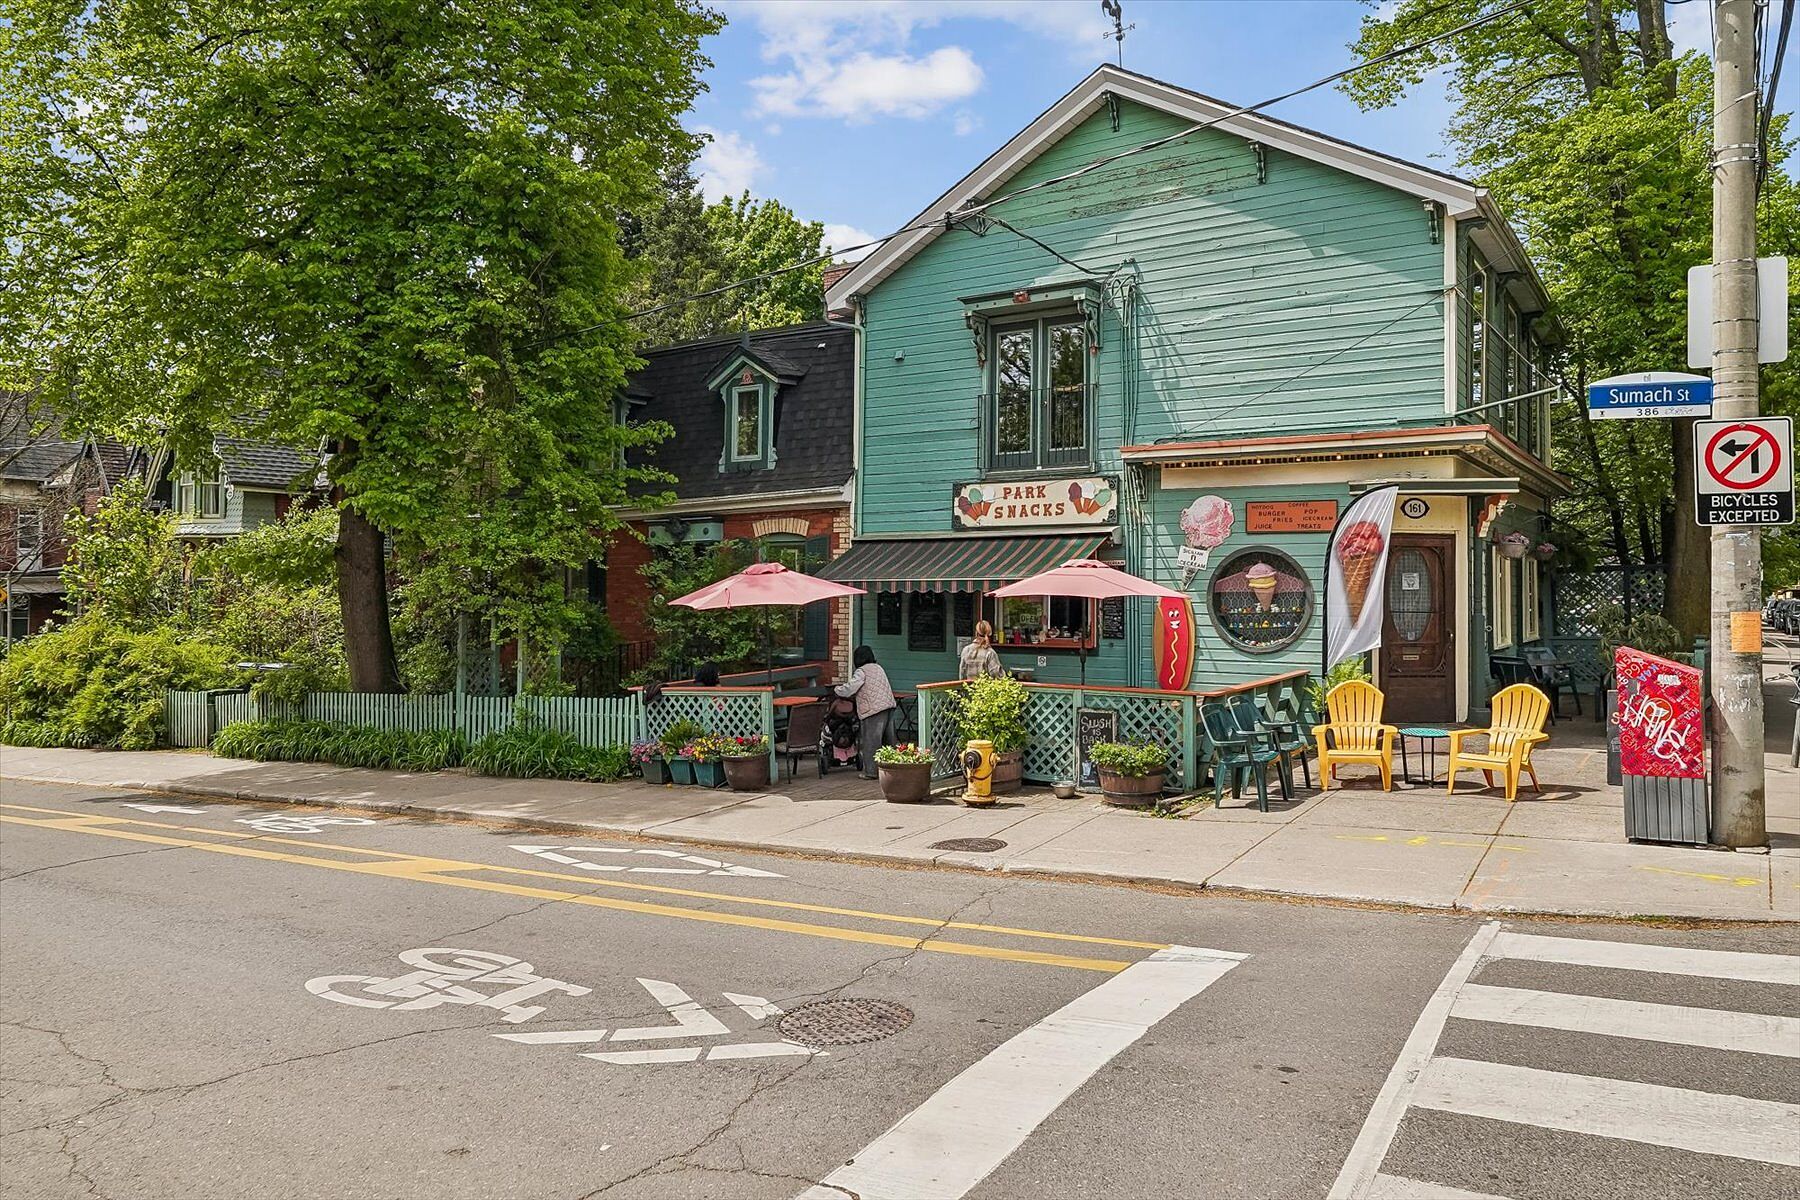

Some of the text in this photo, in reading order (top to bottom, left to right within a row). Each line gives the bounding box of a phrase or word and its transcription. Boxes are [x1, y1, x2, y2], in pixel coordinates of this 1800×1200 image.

[1609, 387, 1690, 404] Sumach St
[1636, 408, 1659, 416] 386
[1003, 485, 1046, 500] PARK
[1410, 504, 1421, 512] 161
[1711, 494, 1778, 508] BICYCLES
[994, 502, 1065, 519] SNACKS
[1709, 509, 1780, 523] EXCEPTED
